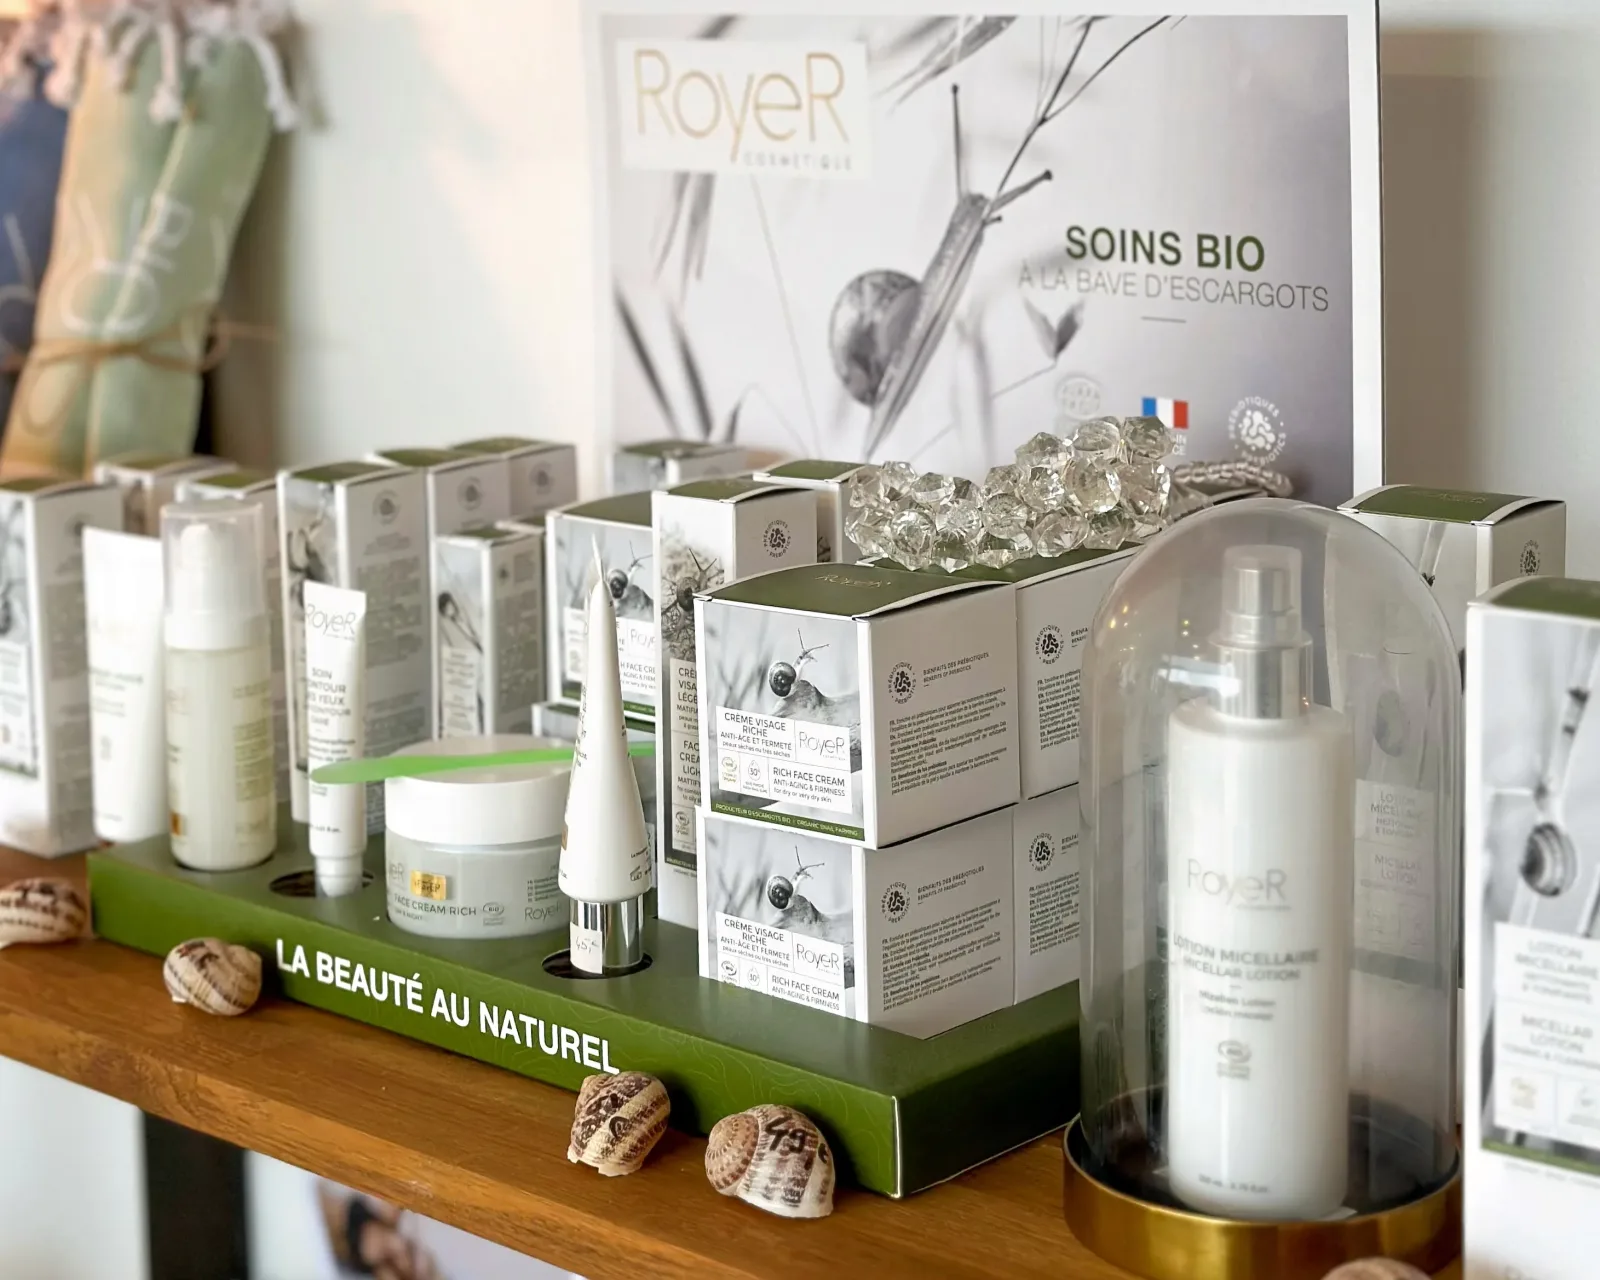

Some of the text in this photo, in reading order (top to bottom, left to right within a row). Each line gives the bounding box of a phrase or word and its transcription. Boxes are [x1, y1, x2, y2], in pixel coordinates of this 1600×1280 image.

[633, 48, 850, 163] RoyeR
[1065, 226, 1265, 272] SOINS BIO
[1041, 267, 1069, 291] LA
[1076, 268, 1137, 297] BAVE
[1145, 274, 1329, 312] D'ESCARGOTS
[1071, 627, 1088, 637] BIENFA
[626, 662, 656, 674] FACE CRE
[678, 667, 697, 679] CRÈ
[678, 679, 697, 691] VISA
[724, 712, 786, 732] CRÈME VISAGE
[742, 725, 768, 738] RICHE
[683, 740, 699, 752] FAC
[752, 737, 760, 745] ET
[799, 731, 845, 756] RoyeR
[679, 752, 700, 764] CREA
[683, 765, 700, 776] LIGH
[773, 767, 845, 788] RICH FACE CREAM
[773, 778, 809, 791] ANTI-AGING
[814, 785, 846, 797] FIRMNESS
[1187, 858, 1288, 906] RoyeR
[412, 900, 446, 915] CREAM
[449, 907, 477, 916] RICH
[742, 933, 767, 947] RICHE
[755, 927, 784, 942] VISAGE
[751, 944, 759, 952] ET
[797, 943, 840, 970] RoyeR
[1173, 933, 1320, 967] LOTION MICELLAIRE
[1183, 956, 1242, 979] MICELLAR
[772, 975, 840, 1001] RICH FACE CREAM
[276, 938, 621, 1076] LA BEAUTÉ AU NATUREL
[772, 986, 805, 1001] ANTI-AGING
[811, 995, 840, 1011] FIRMNESS
